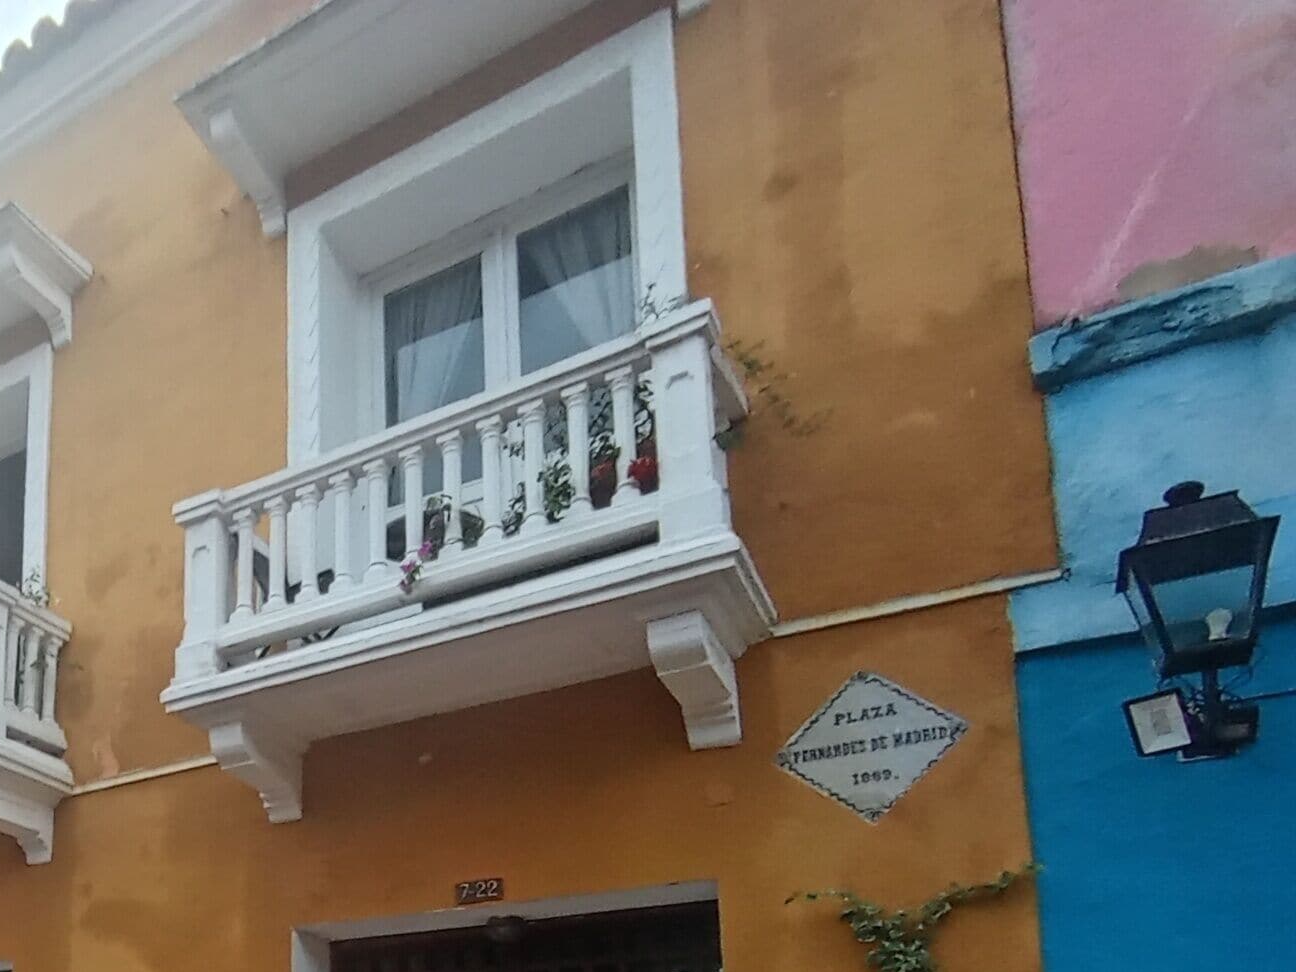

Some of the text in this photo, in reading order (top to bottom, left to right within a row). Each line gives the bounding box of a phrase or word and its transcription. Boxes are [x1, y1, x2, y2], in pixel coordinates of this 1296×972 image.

[834, 703, 898, 726] PLAZA
[870, 736, 888, 752] DE
[893, 727, 948, 748] MADRID
[459, 880, 498, 899] 7-22
